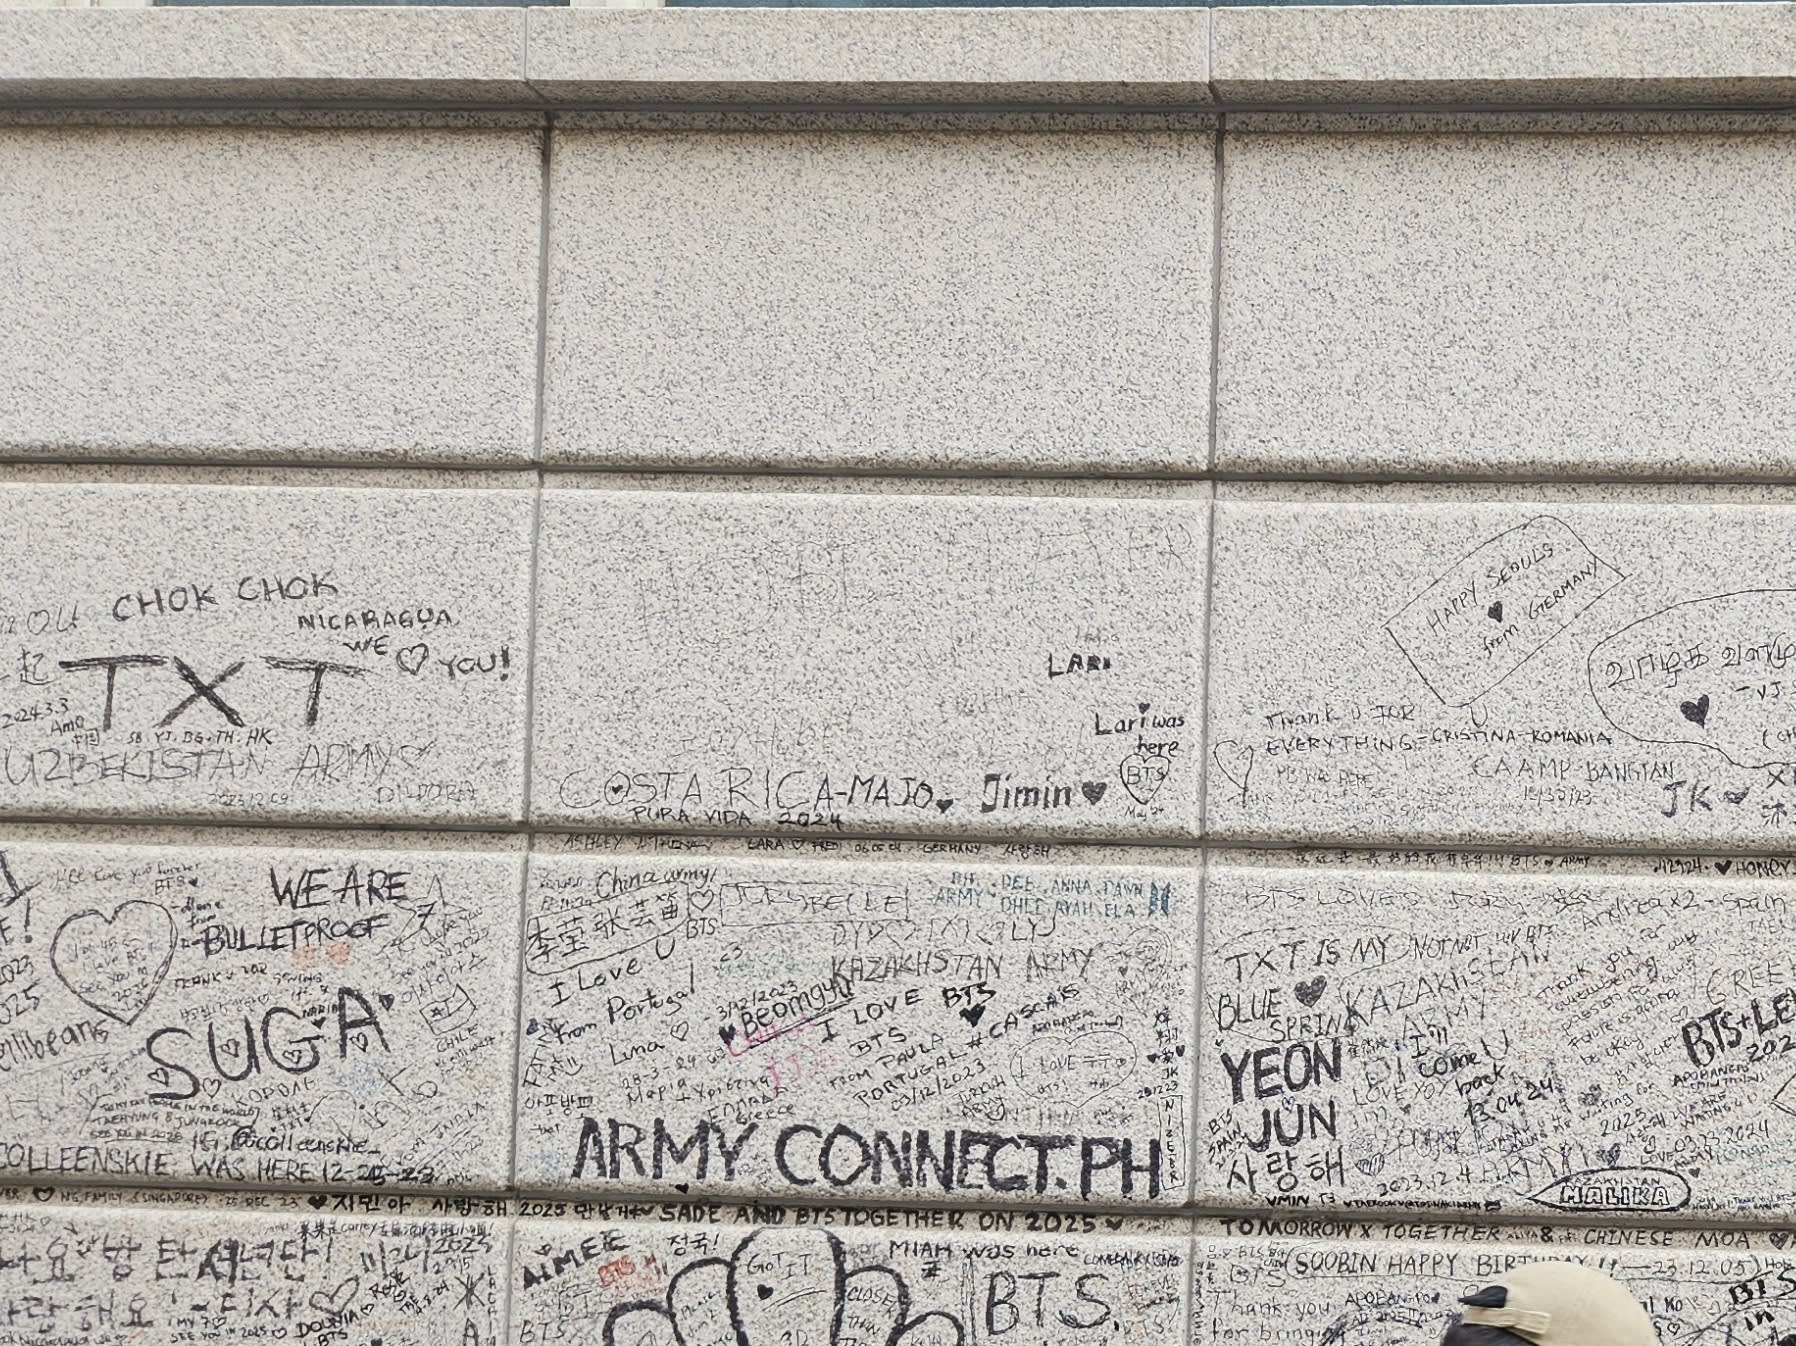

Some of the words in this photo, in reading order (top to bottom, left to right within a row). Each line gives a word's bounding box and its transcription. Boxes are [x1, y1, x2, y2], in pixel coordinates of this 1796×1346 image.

[113, 582, 218, 623] CHOK
[237, 572, 338, 602] CHOK
[1424, 582, 1478, 634] HAPPY
[1526, 557, 1602, 625] GERMANY
[439, 646, 510, 682] YOU!
[60, 654, 373, 731] TXT
[1153, 714, 1185, 730] was
[1137, 735, 1180, 757] here
[559, 770, 702, 808] COSTA
[981, 772, 1072, 813] Jimin
[1660, 778, 1712, 818] JK
[704, 808, 752, 826] VIDA
[778, 810, 843, 829] 2024
[270, 867, 328, 909] WE
[334, 864, 410, 901] ARE
[830, 948, 1004, 985] KAZAKHSTAN
[1225, 943, 1308, 982] TXT
[852, 987, 925, 1027] LOVE
[942, 980, 997, 1008] BTS
[1215, 987, 1282, 1033] BLUE
[146, 985, 388, 1101] SUGA
[879, 1034, 946, 1070] PAULA
[852, 1046, 967, 1108] PORTUGAL
[1218, 1038, 1344, 1106] YEON
[1416, 1050, 1483, 1080] come
[1241, 1101, 1339, 1153] JUN
[191, 1157, 244, 1179] WAS
[257, 1157, 320, 1180] HERE
[571, 1116, 760, 1183] ARMY
[1226, 1149, 1346, 1194] 사랑해
[332, 1194, 413, 1214] 지민아
[431, 1196, 507, 1218] 사랑해
[1559, 1184, 1669, 1208] MALIKA
[657, 1203, 728, 1225] SADE
[732, 1203, 788, 1226] AND
[838, 1207, 965, 1230] TOGETHER
[977, 1209, 1019, 1232] ON
[1025, 1211, 1110, 1233] 2025
[1219, 1218, 1357, 1240] TOMORROW
[1381, 1222, 1502, 1243] TOGETHER
[1584, 1229, 1674, 1249] CHINESE
[1695, 1230, 1751, 1249] MOA
[889, 1239, 953, 1260] MIAH
[963, 1243, 1016, 1260] was
[1024, 1241, 1081, 1258] here
[1293, 1250, 1380, 1276] SOOBIN
[1387, 1251, 1459, 1277] HAPPY
[297, 1310, 361, 1340] DOUNIA
